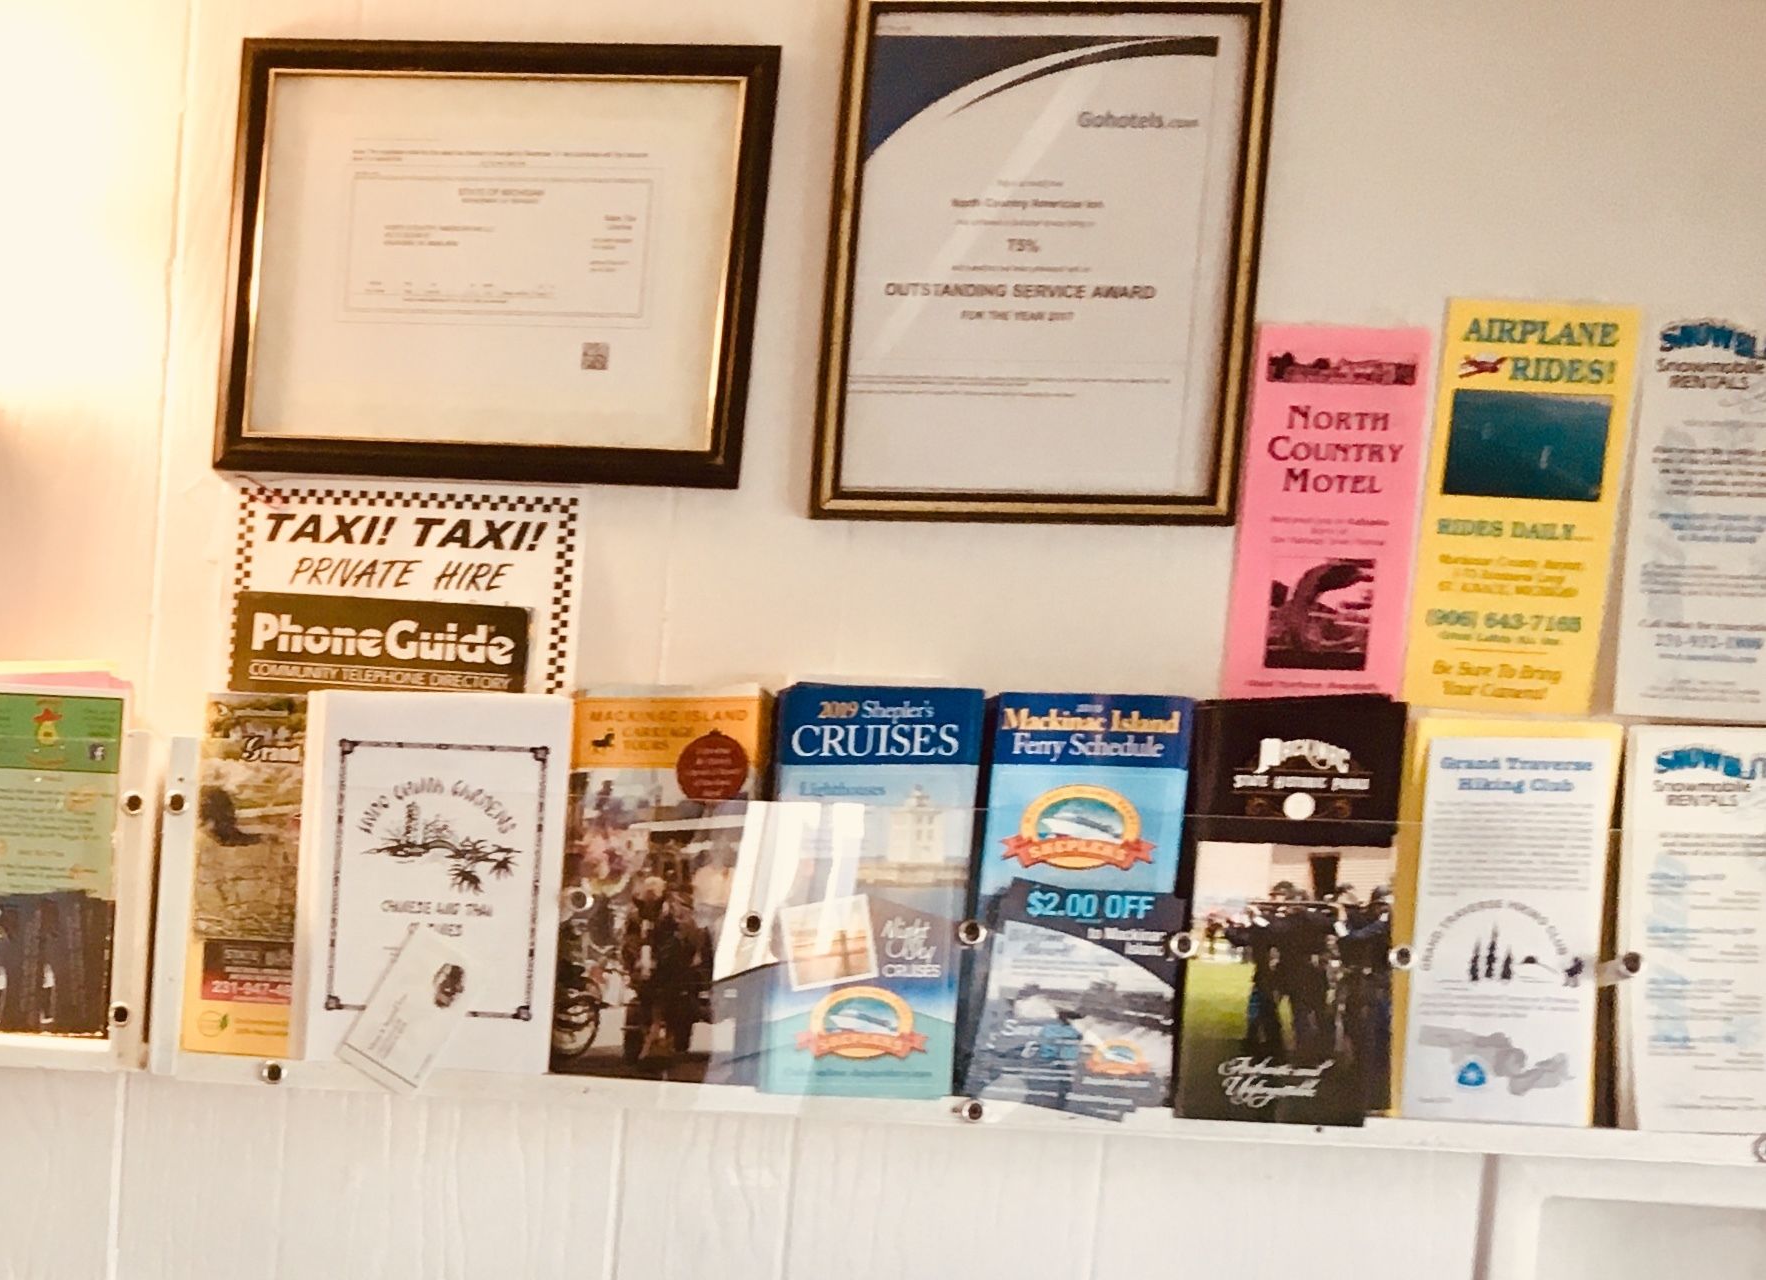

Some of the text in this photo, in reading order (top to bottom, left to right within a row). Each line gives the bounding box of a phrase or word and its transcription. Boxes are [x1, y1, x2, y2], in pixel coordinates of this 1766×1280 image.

[884, 282, 1158, 300] OUTSTANDING SERVICE AWARD
[1462, 317, 1621, 348] AIRPLANE
[1508, 356, 1618, 385] RIDES!
[1287, 404, 1390, 431] NORTH
[1267, 436, 1404, 463] COUNTRY
[1282, 468, 1384, 494] MOTEL
[265, 512, 549, 552] TAXI! TAXI!
[288, 556, 515, 592] PRIVATE HIRE
[250, 611, 517, 667] PhoneGuide
[247, 661, 514, 692] COMMUNITY TELEPHONE DIRECTORY
[817, 699, 936, 725] 2019 Shepler's
[1001, 707, 1182, 735] Mackinac Island
[790, 723, 961, 758] CRUISES
[1011, 732, 1166, 763] Ferry Schedule
[1439, 756, 1594, 772] Grand Traverse
[1457, 777, 1576, 794] Hiking Club
[1025, 890, 1156, 919] $2.00 OFF
[881, 963, 943, 979] CRUISES
